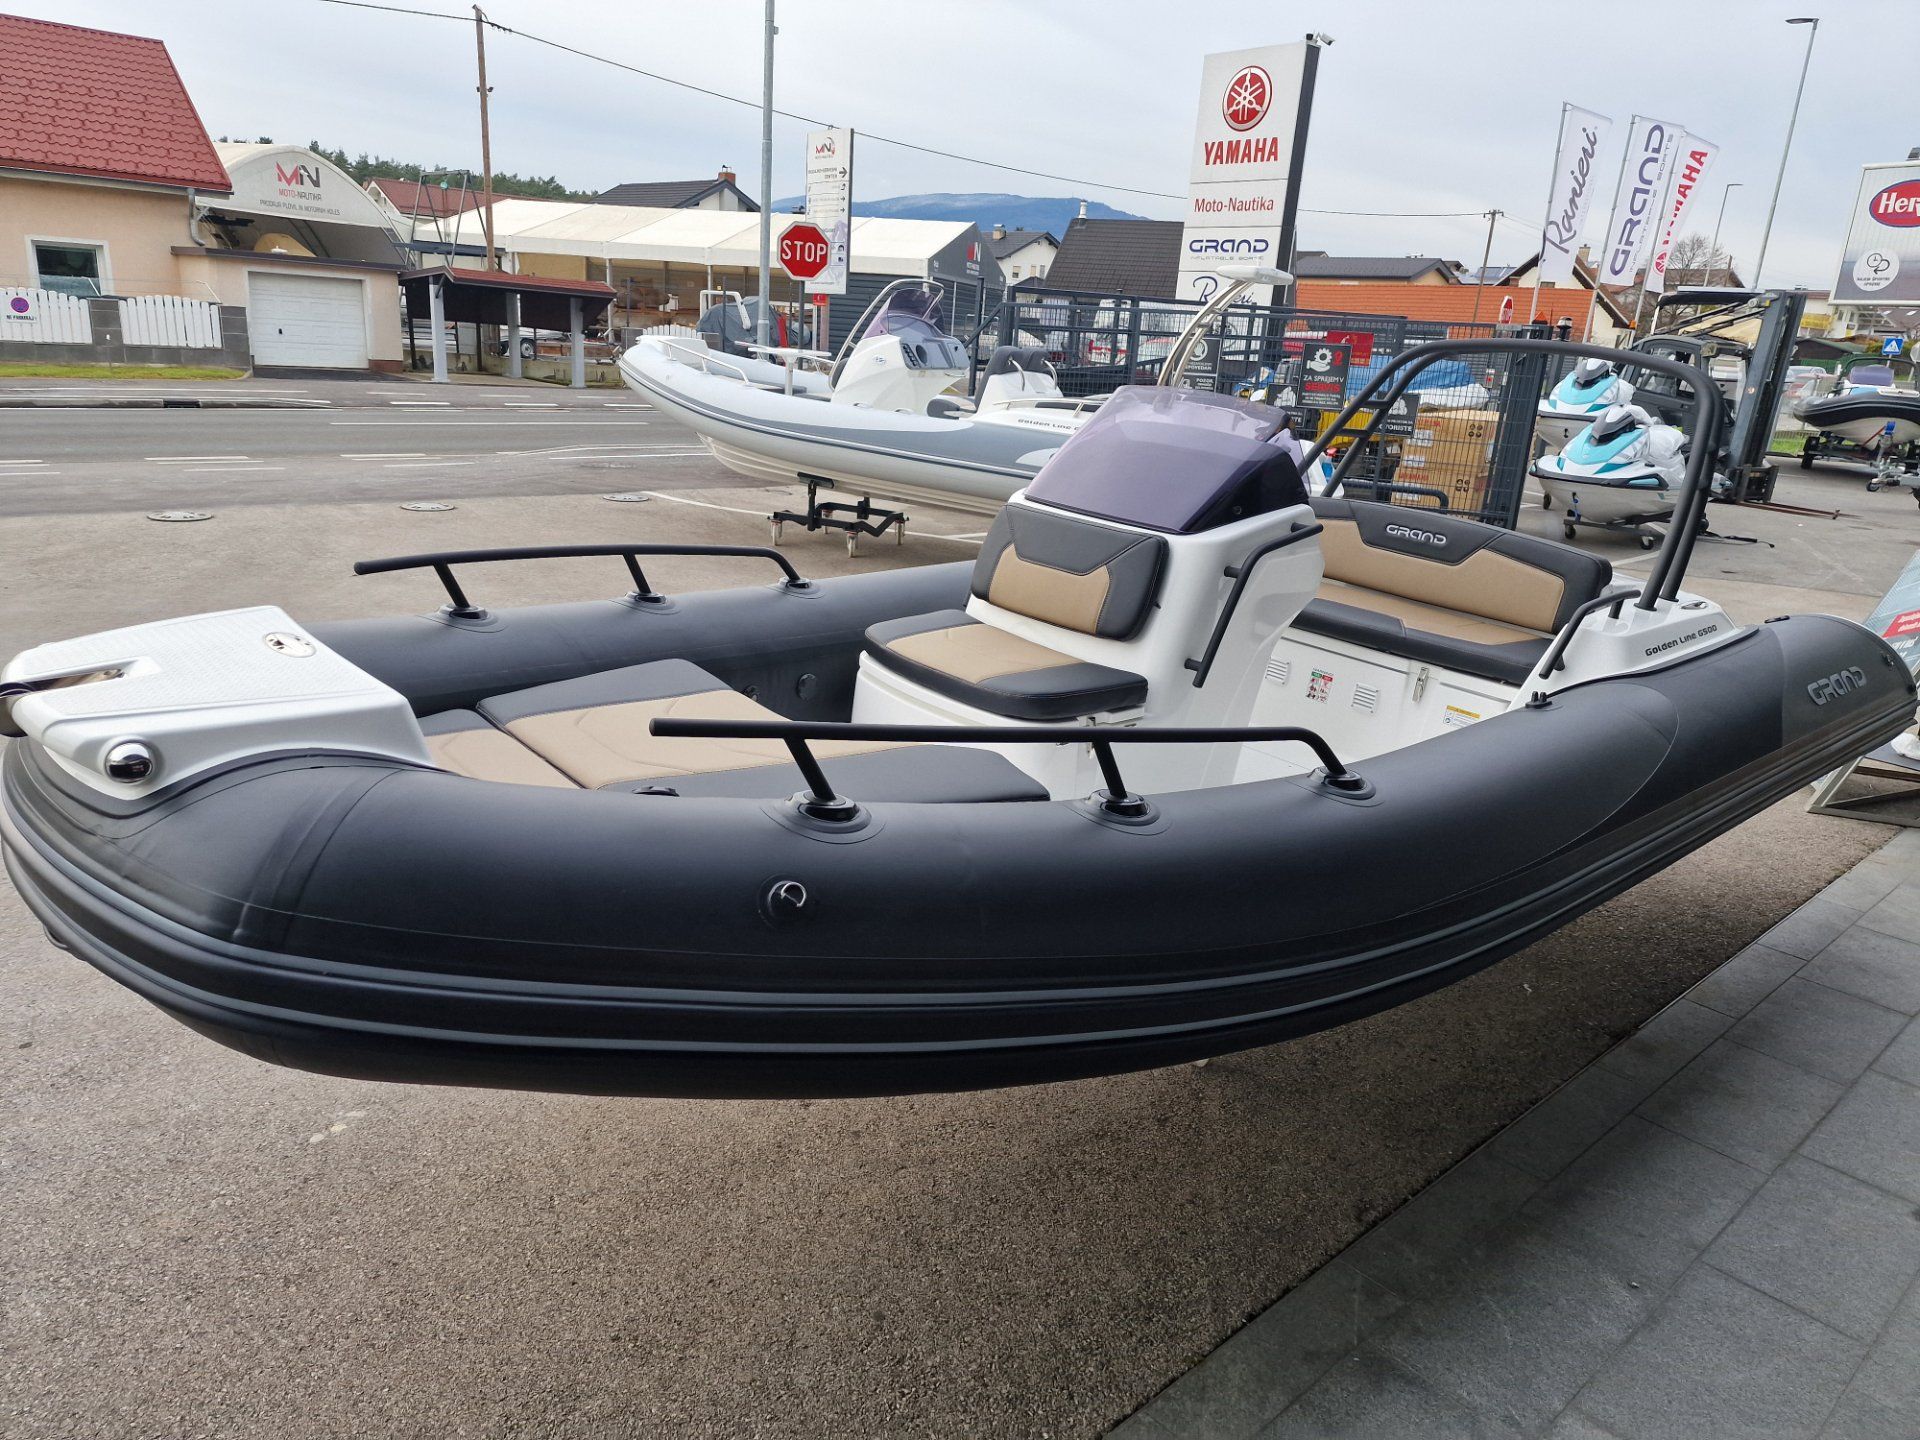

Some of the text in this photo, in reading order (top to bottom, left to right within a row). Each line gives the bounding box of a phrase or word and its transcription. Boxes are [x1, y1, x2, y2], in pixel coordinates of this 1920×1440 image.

[1204, 137, 1278, 166] YAMAHA
[275, 162, 320, 188] MN
[279, 188, 322, 201] MOTO-NAUTIKA
[1194, 196, 1274, 213] Moto-Nautika
[1540, 127, 1597, 261] Ranieri
[1610, 124, 1664, 276] GRAND
[781, 240, 827, 263] STOP
[1189, 239, 1269, 253] GRAND
[1304, 382, 1340, 393] SERVIS
[1386, 524, 1447, 545] GRAND
[1645, 624, 1718, 657] Golden Line G500
[1807, 666, 1867, 706] GRAND
